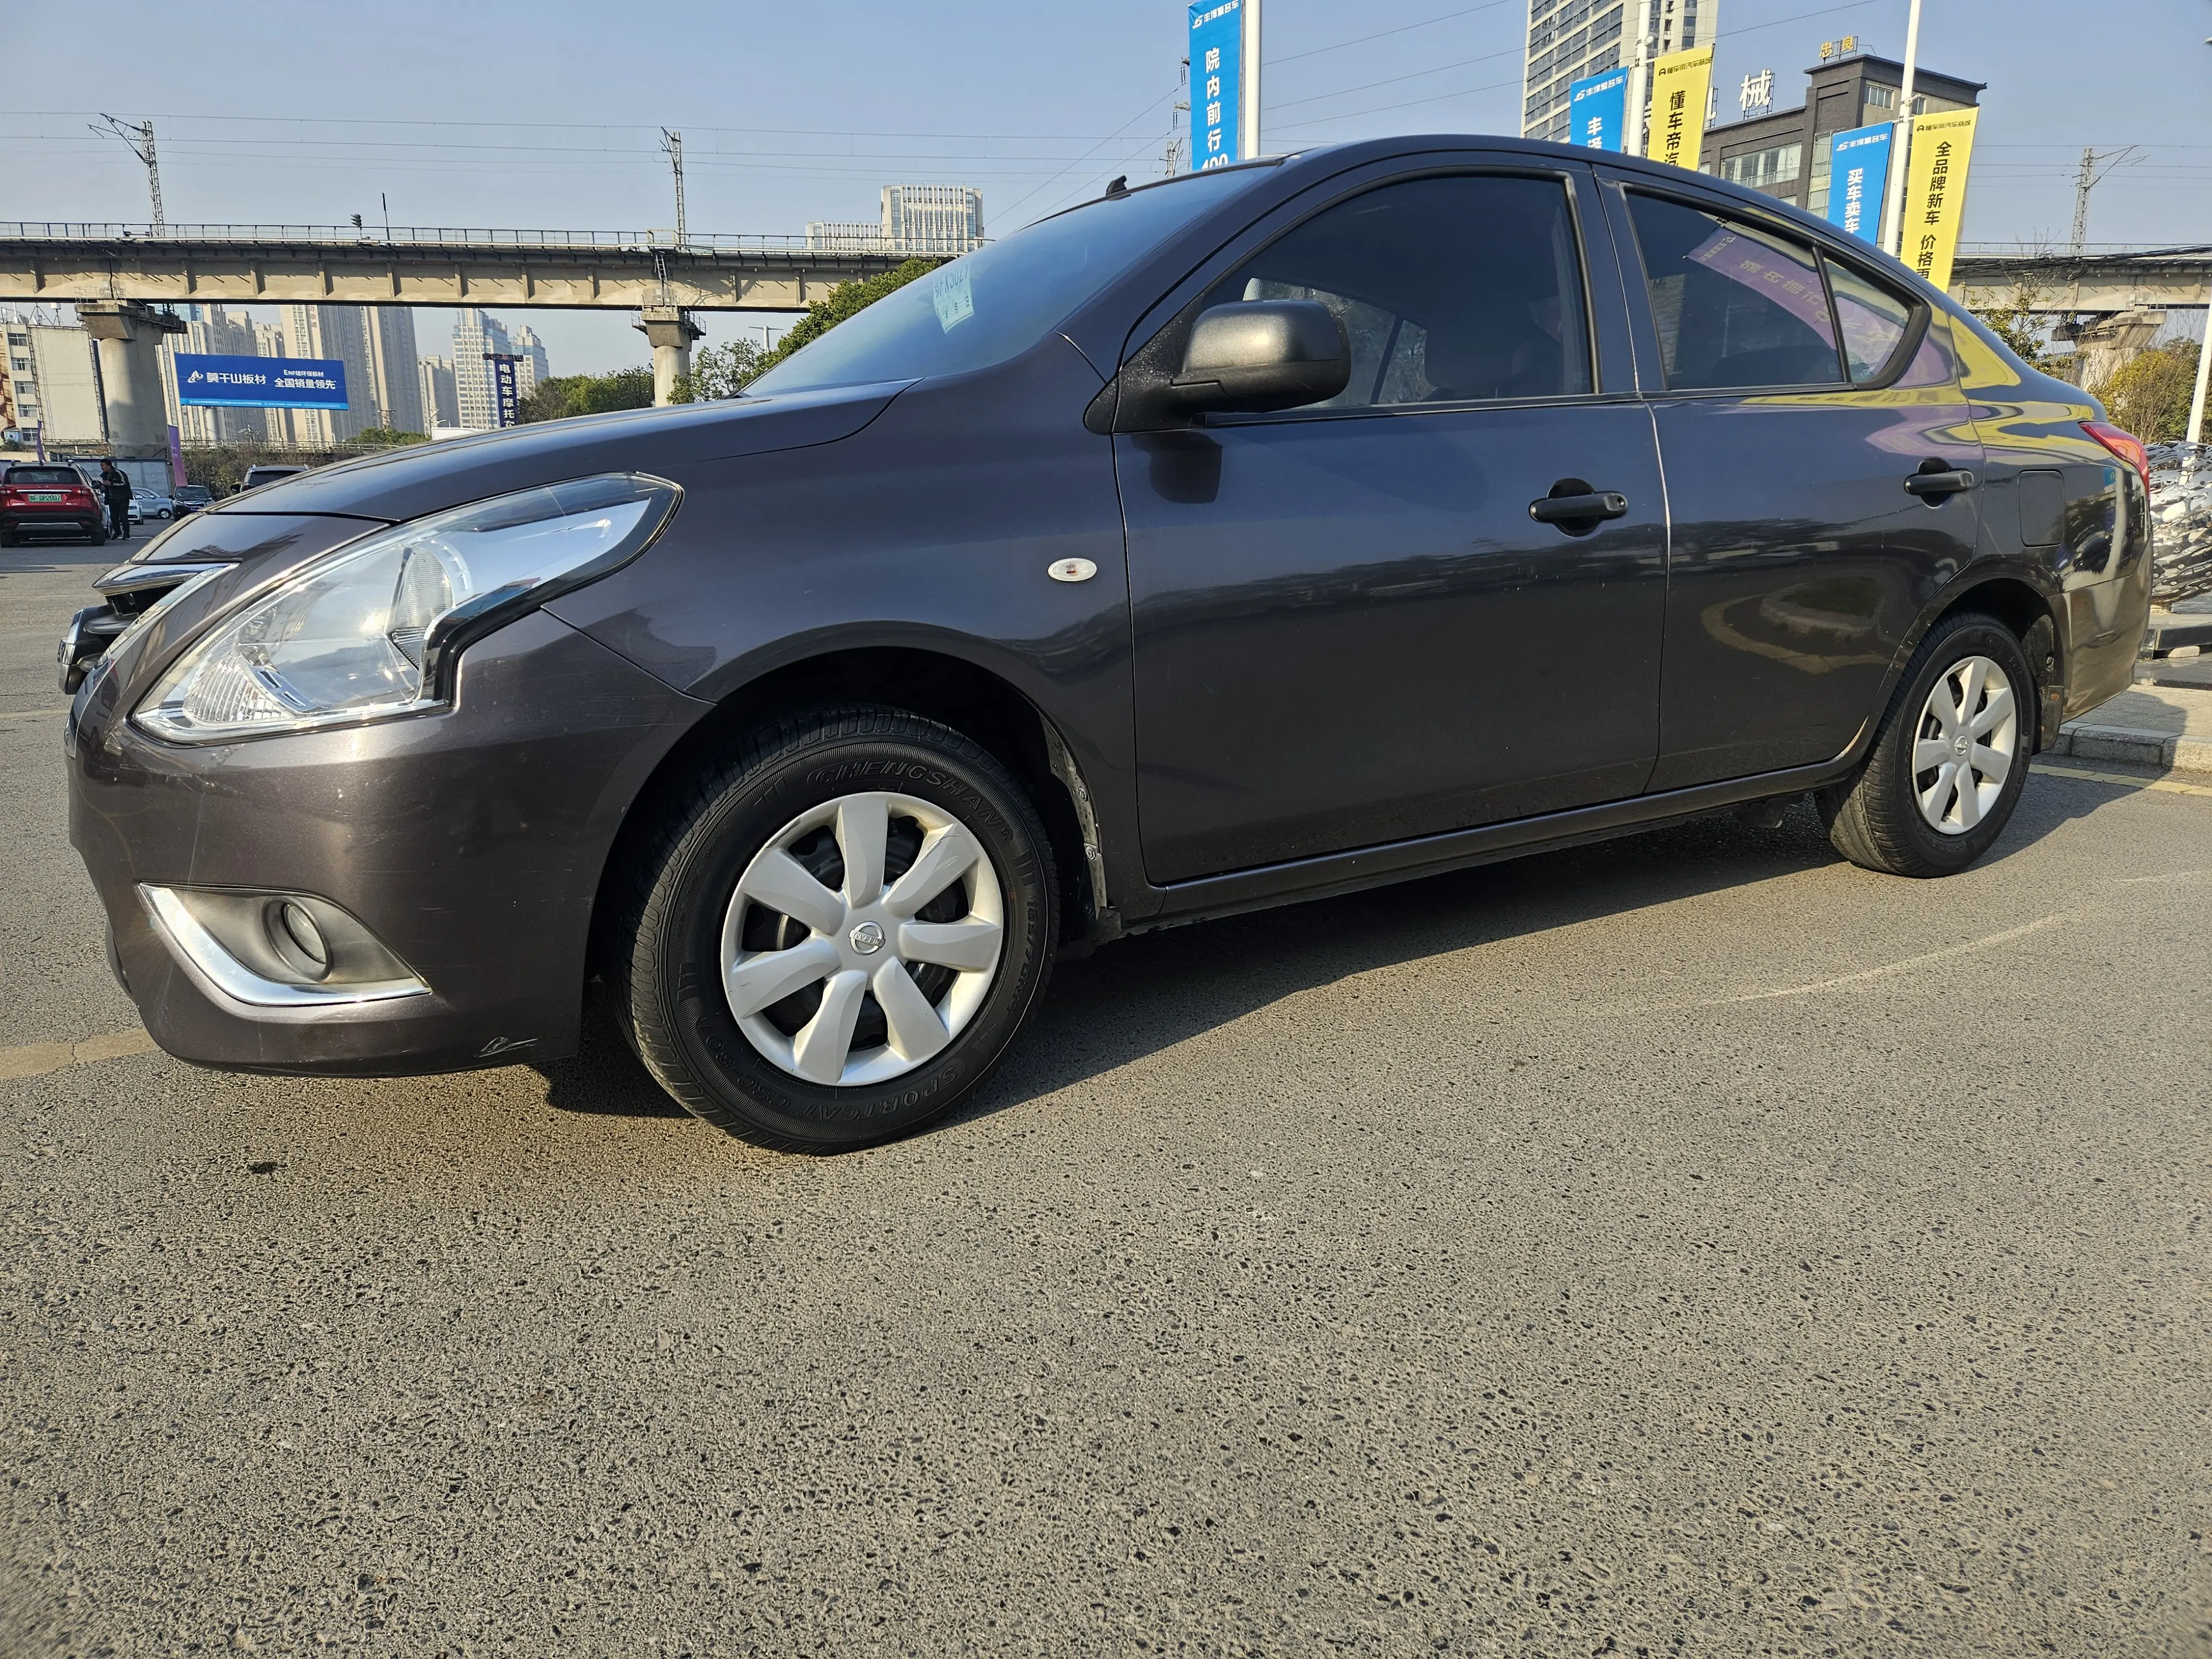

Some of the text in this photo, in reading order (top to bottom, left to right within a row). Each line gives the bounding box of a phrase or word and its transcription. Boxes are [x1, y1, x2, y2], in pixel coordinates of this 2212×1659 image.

[1206, 47, 1222, 153] 院内前行
[1739, 69, 1773, 111] 械
[1665, 90, 1686, 166] 懂车帝汽
[1844, 168, 1863, 233] 买车卖车
[1924, 141, 1952, 225] 全品牌新车
[206, 372, 267, 384] 莫干山板材
[274, 378, 336, 389] 全国销量领先
[816, 760, 1005, 827] CHENGSHAN
[801, 1067, 958, 1121] SPORTCAT
